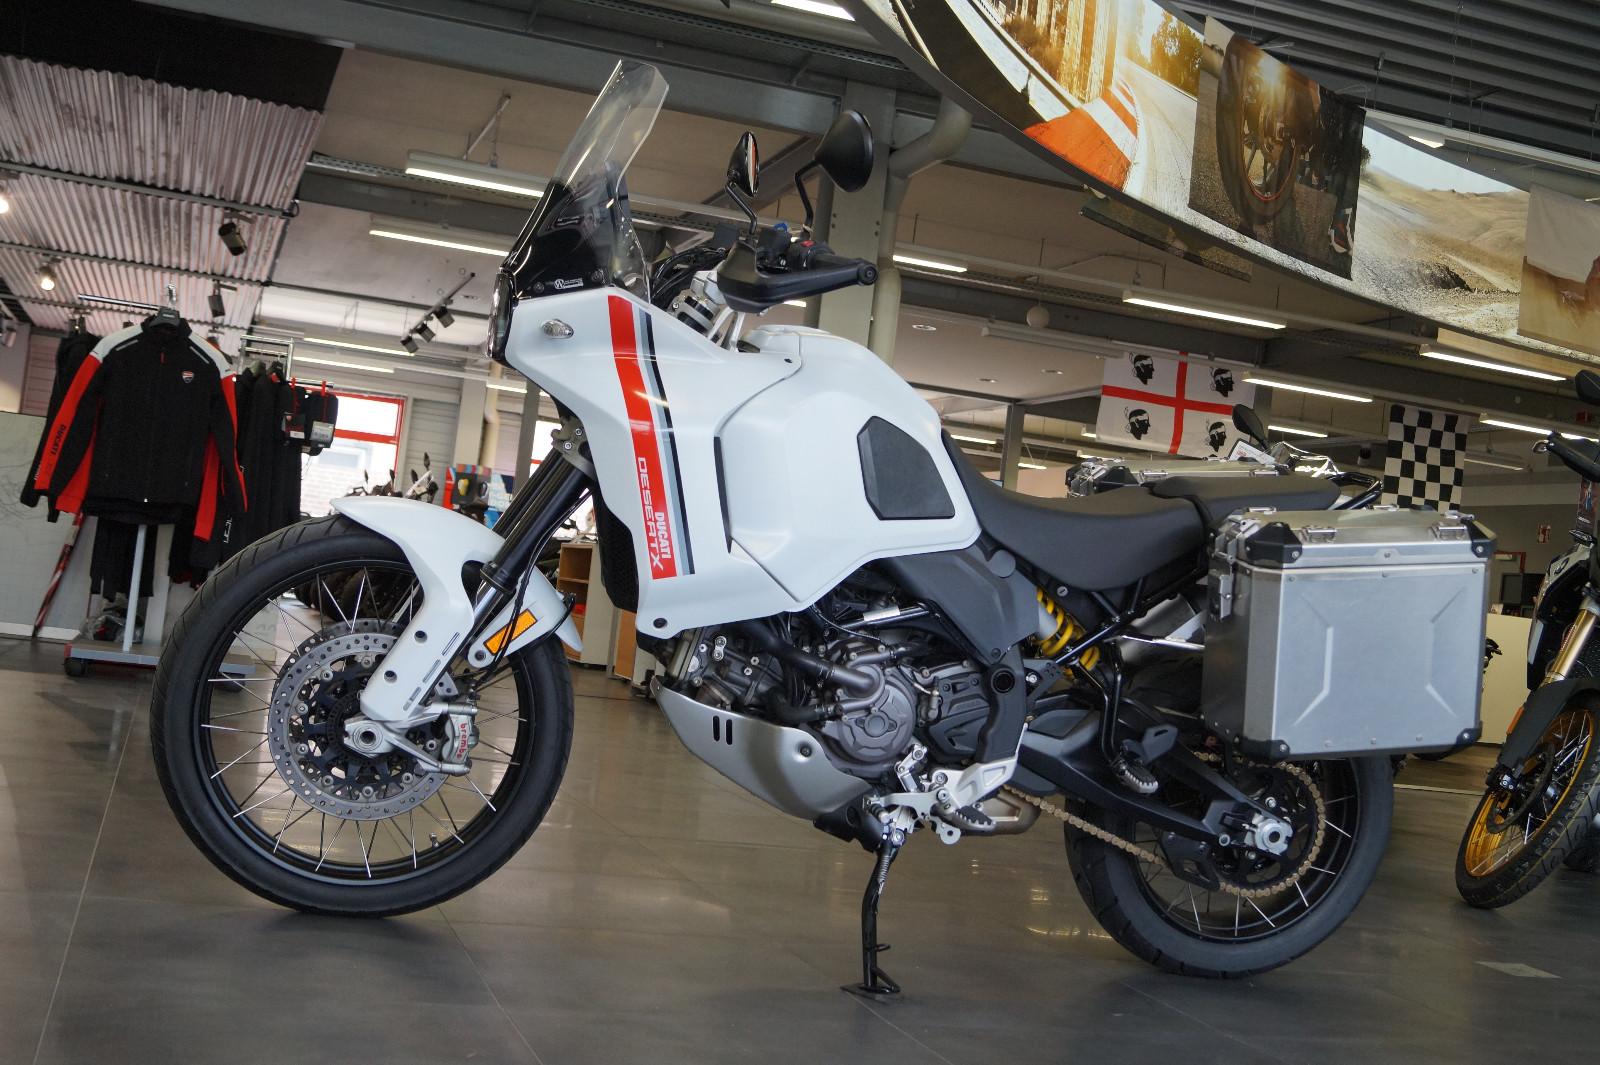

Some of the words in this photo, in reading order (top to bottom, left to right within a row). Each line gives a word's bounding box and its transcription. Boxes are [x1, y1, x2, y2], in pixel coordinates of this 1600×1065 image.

[638, 457, 664, 571] DESERTX
[655, 511, 672, 559] DUCATI
[456, 722, 468, 759] brembo
